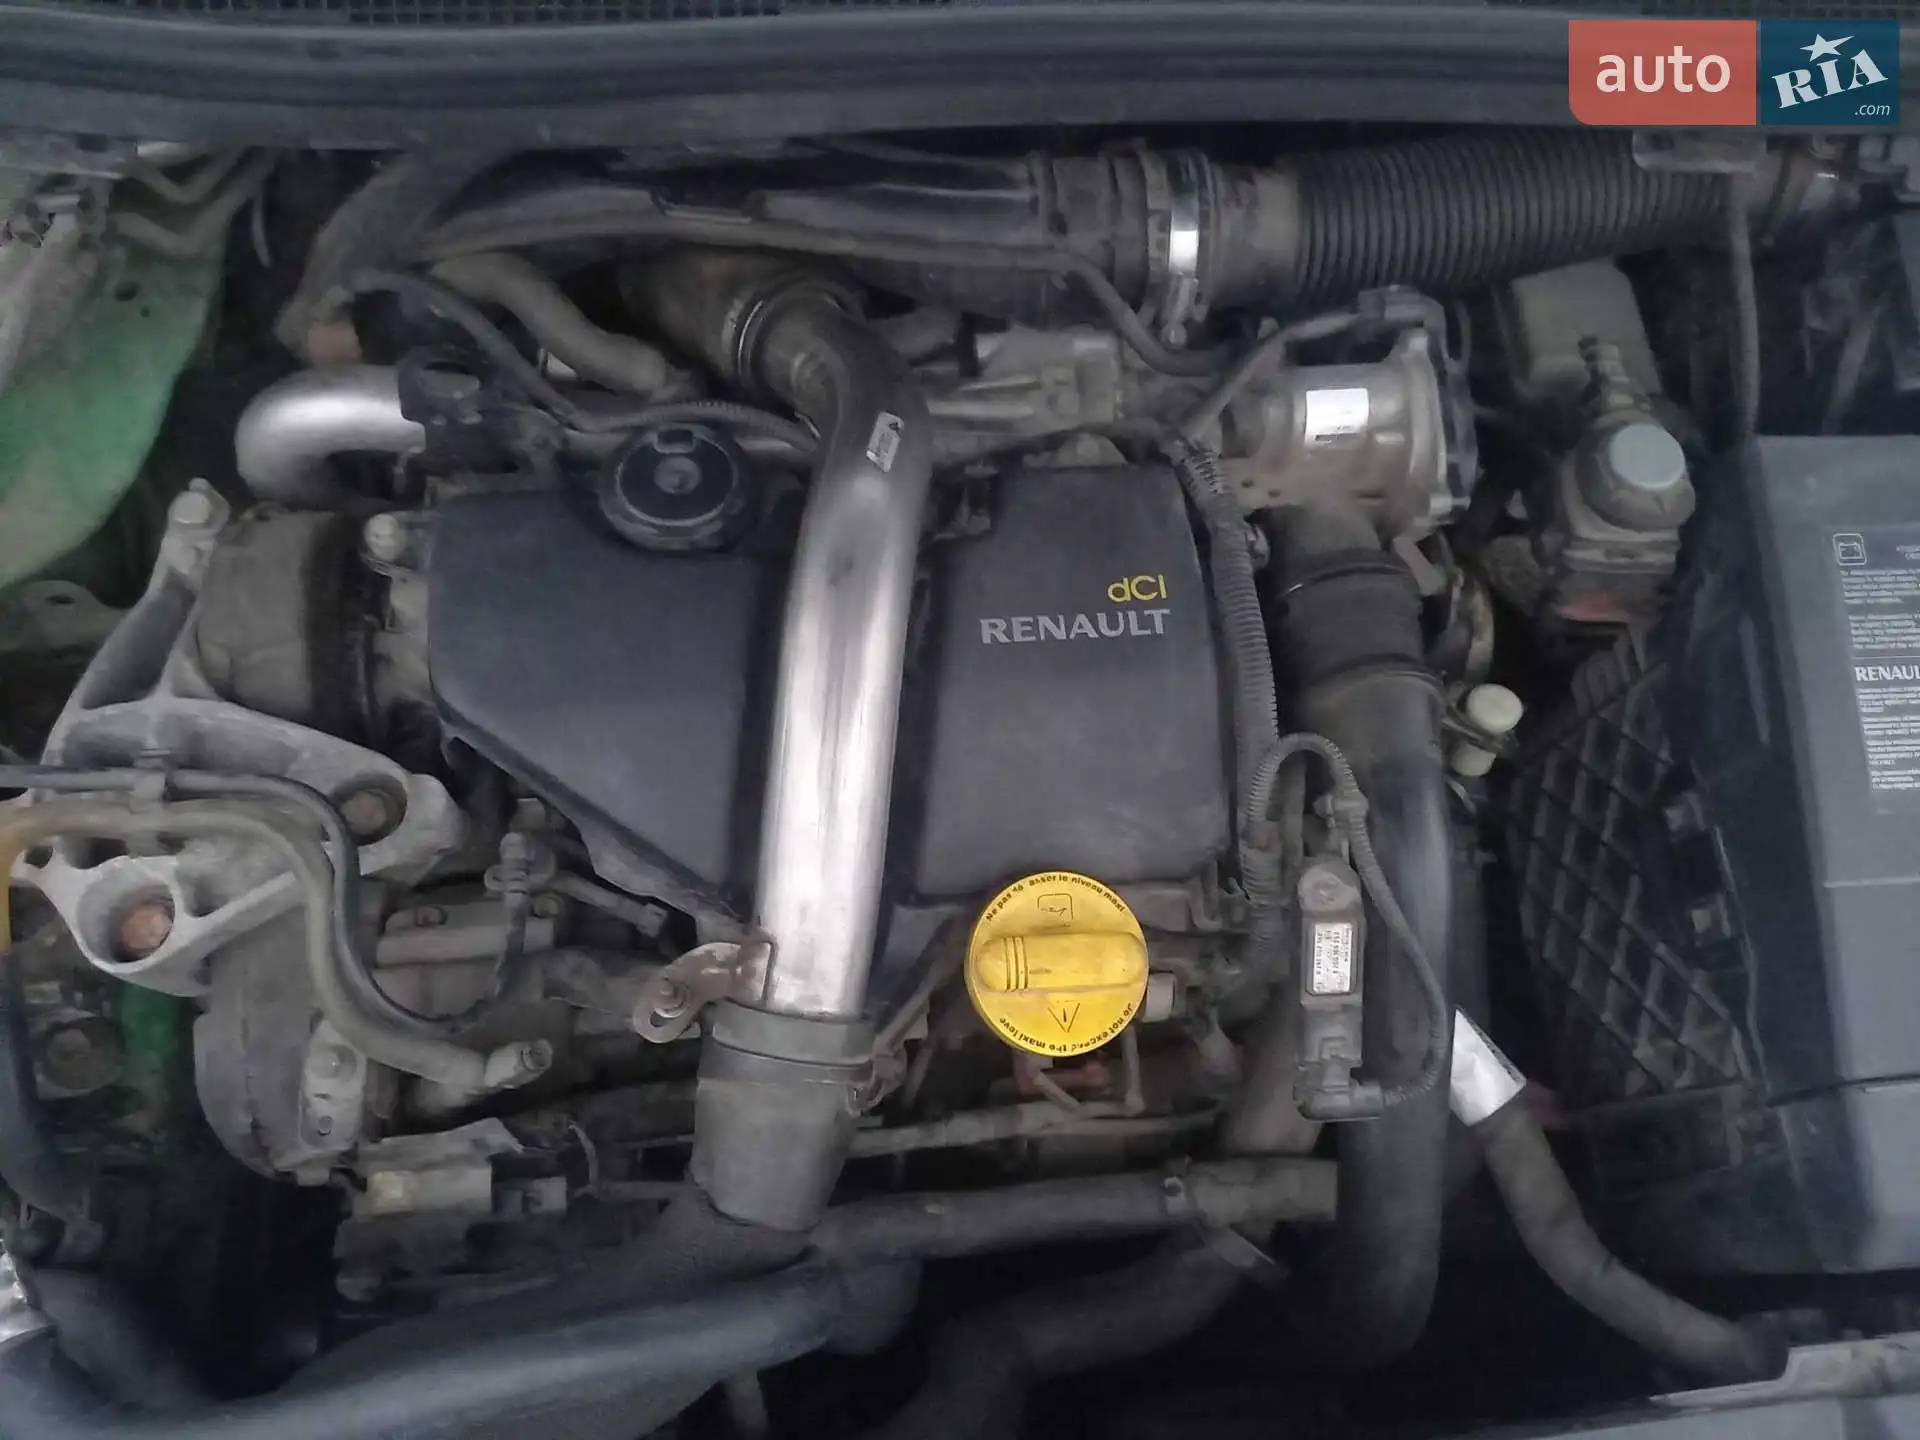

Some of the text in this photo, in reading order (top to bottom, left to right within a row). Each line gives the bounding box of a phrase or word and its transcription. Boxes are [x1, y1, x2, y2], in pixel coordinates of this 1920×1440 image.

[979, 608, 1171, 645] RENAULT
[1071, 877, 1104, 894] niveau
[1104, 892, 1126, 913] maxi
[1000, 1017, 1017, 1037] leve
[1110, 1018, 1124, 1033] not
[1018, 1033, 1046, 1049] maxi
